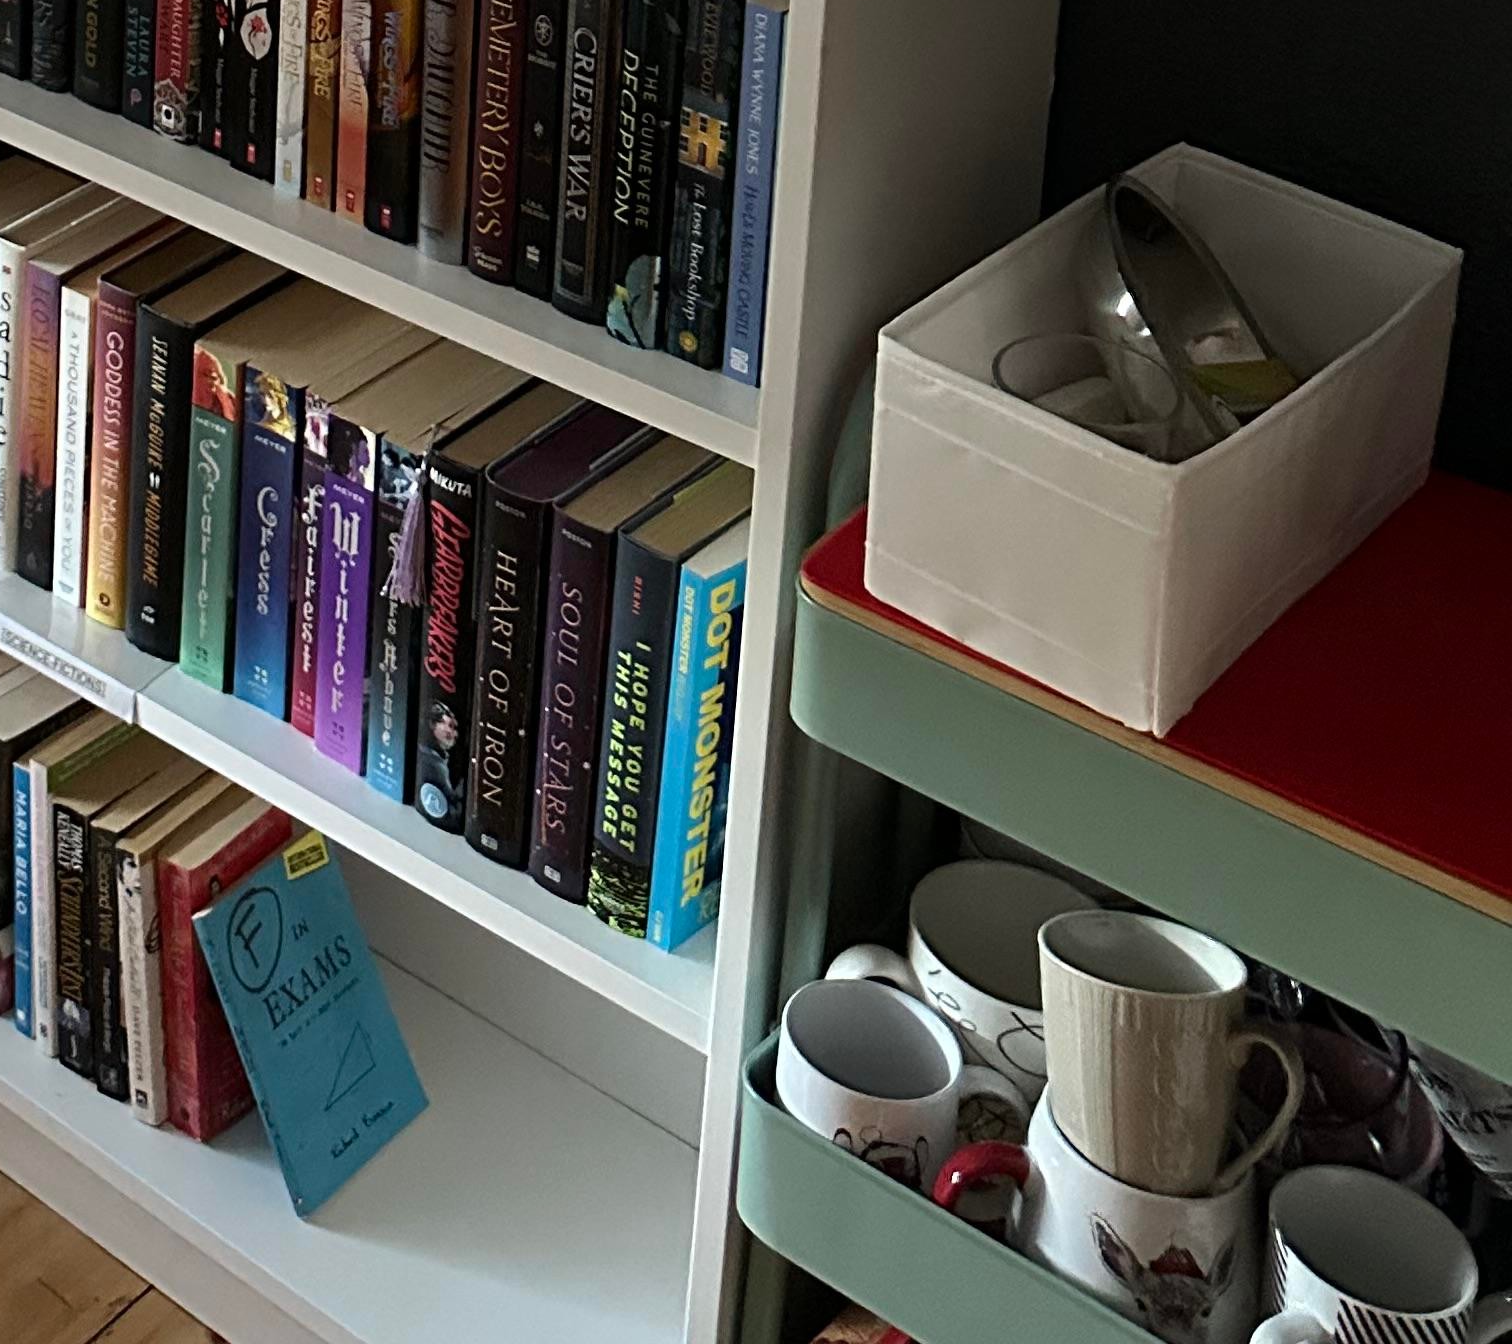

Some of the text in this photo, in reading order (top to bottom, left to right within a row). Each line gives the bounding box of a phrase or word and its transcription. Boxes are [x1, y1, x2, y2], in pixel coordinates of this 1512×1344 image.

[562, 26, 599, 222] CRIER'S WAR
[611, 49, 639, 227] DECEPTION
[743, 13, 769, 176] DIANA WYNNE JONES
[473, 147, 508, 238] BOYS
[140, 335, 170, 587] SEANAN McGUIRE MIDDLEGAME
[425, 467, 473, 499] MIKUTA
[422, 499, 471, 696] GEARBREAKERS
[476, 549, 519, 808] HEART OF IRON
[599, 650, 632, 840] THIS MESSAGE
[616, 663, 650, 854] HOPE YOU GET
[677, 581, 736, 909] DOT MONSTER
[11, 789, 29, 916] MARIA BELLO
[54, 810, 73, 871] KENEALLY
[67, 823, 85, 872] THOMAS
[234, 903, 262, 969] F
[260, 935, 353, 1031] EXAMS
[291, 918, 309, 942] IN
